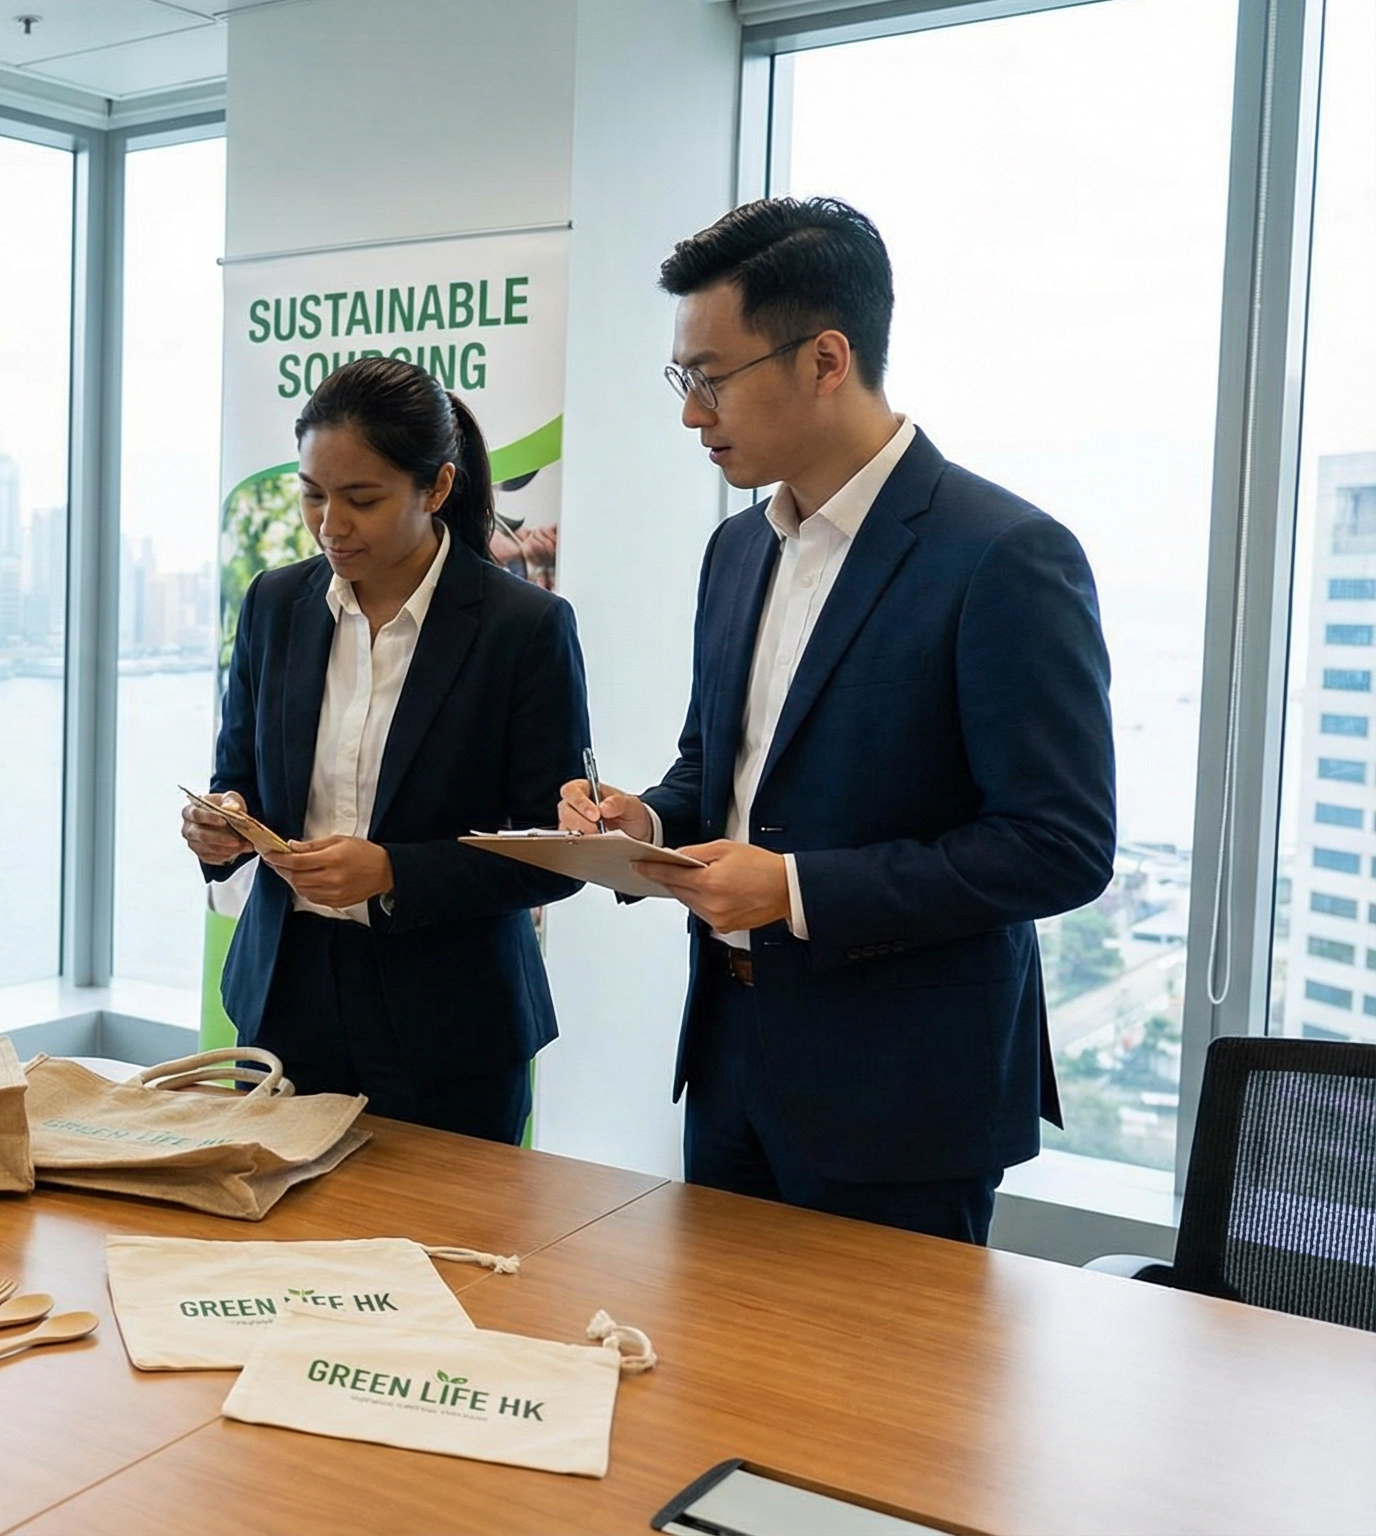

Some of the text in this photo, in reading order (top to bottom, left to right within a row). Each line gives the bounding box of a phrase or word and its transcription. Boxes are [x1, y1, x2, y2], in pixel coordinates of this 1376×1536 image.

[248, 276, 529, 343] SUSTAINABLE
[278, 341, 486, 398] SOING
[179, 1297, 278, 1317] GREEN
[353, 1292, 399, 1313] HK
[307, 1358, 412, 1399] GREEN
[420, 1379, 490, 1412] LIFE
[498, 1395, 545, 1422] HK
